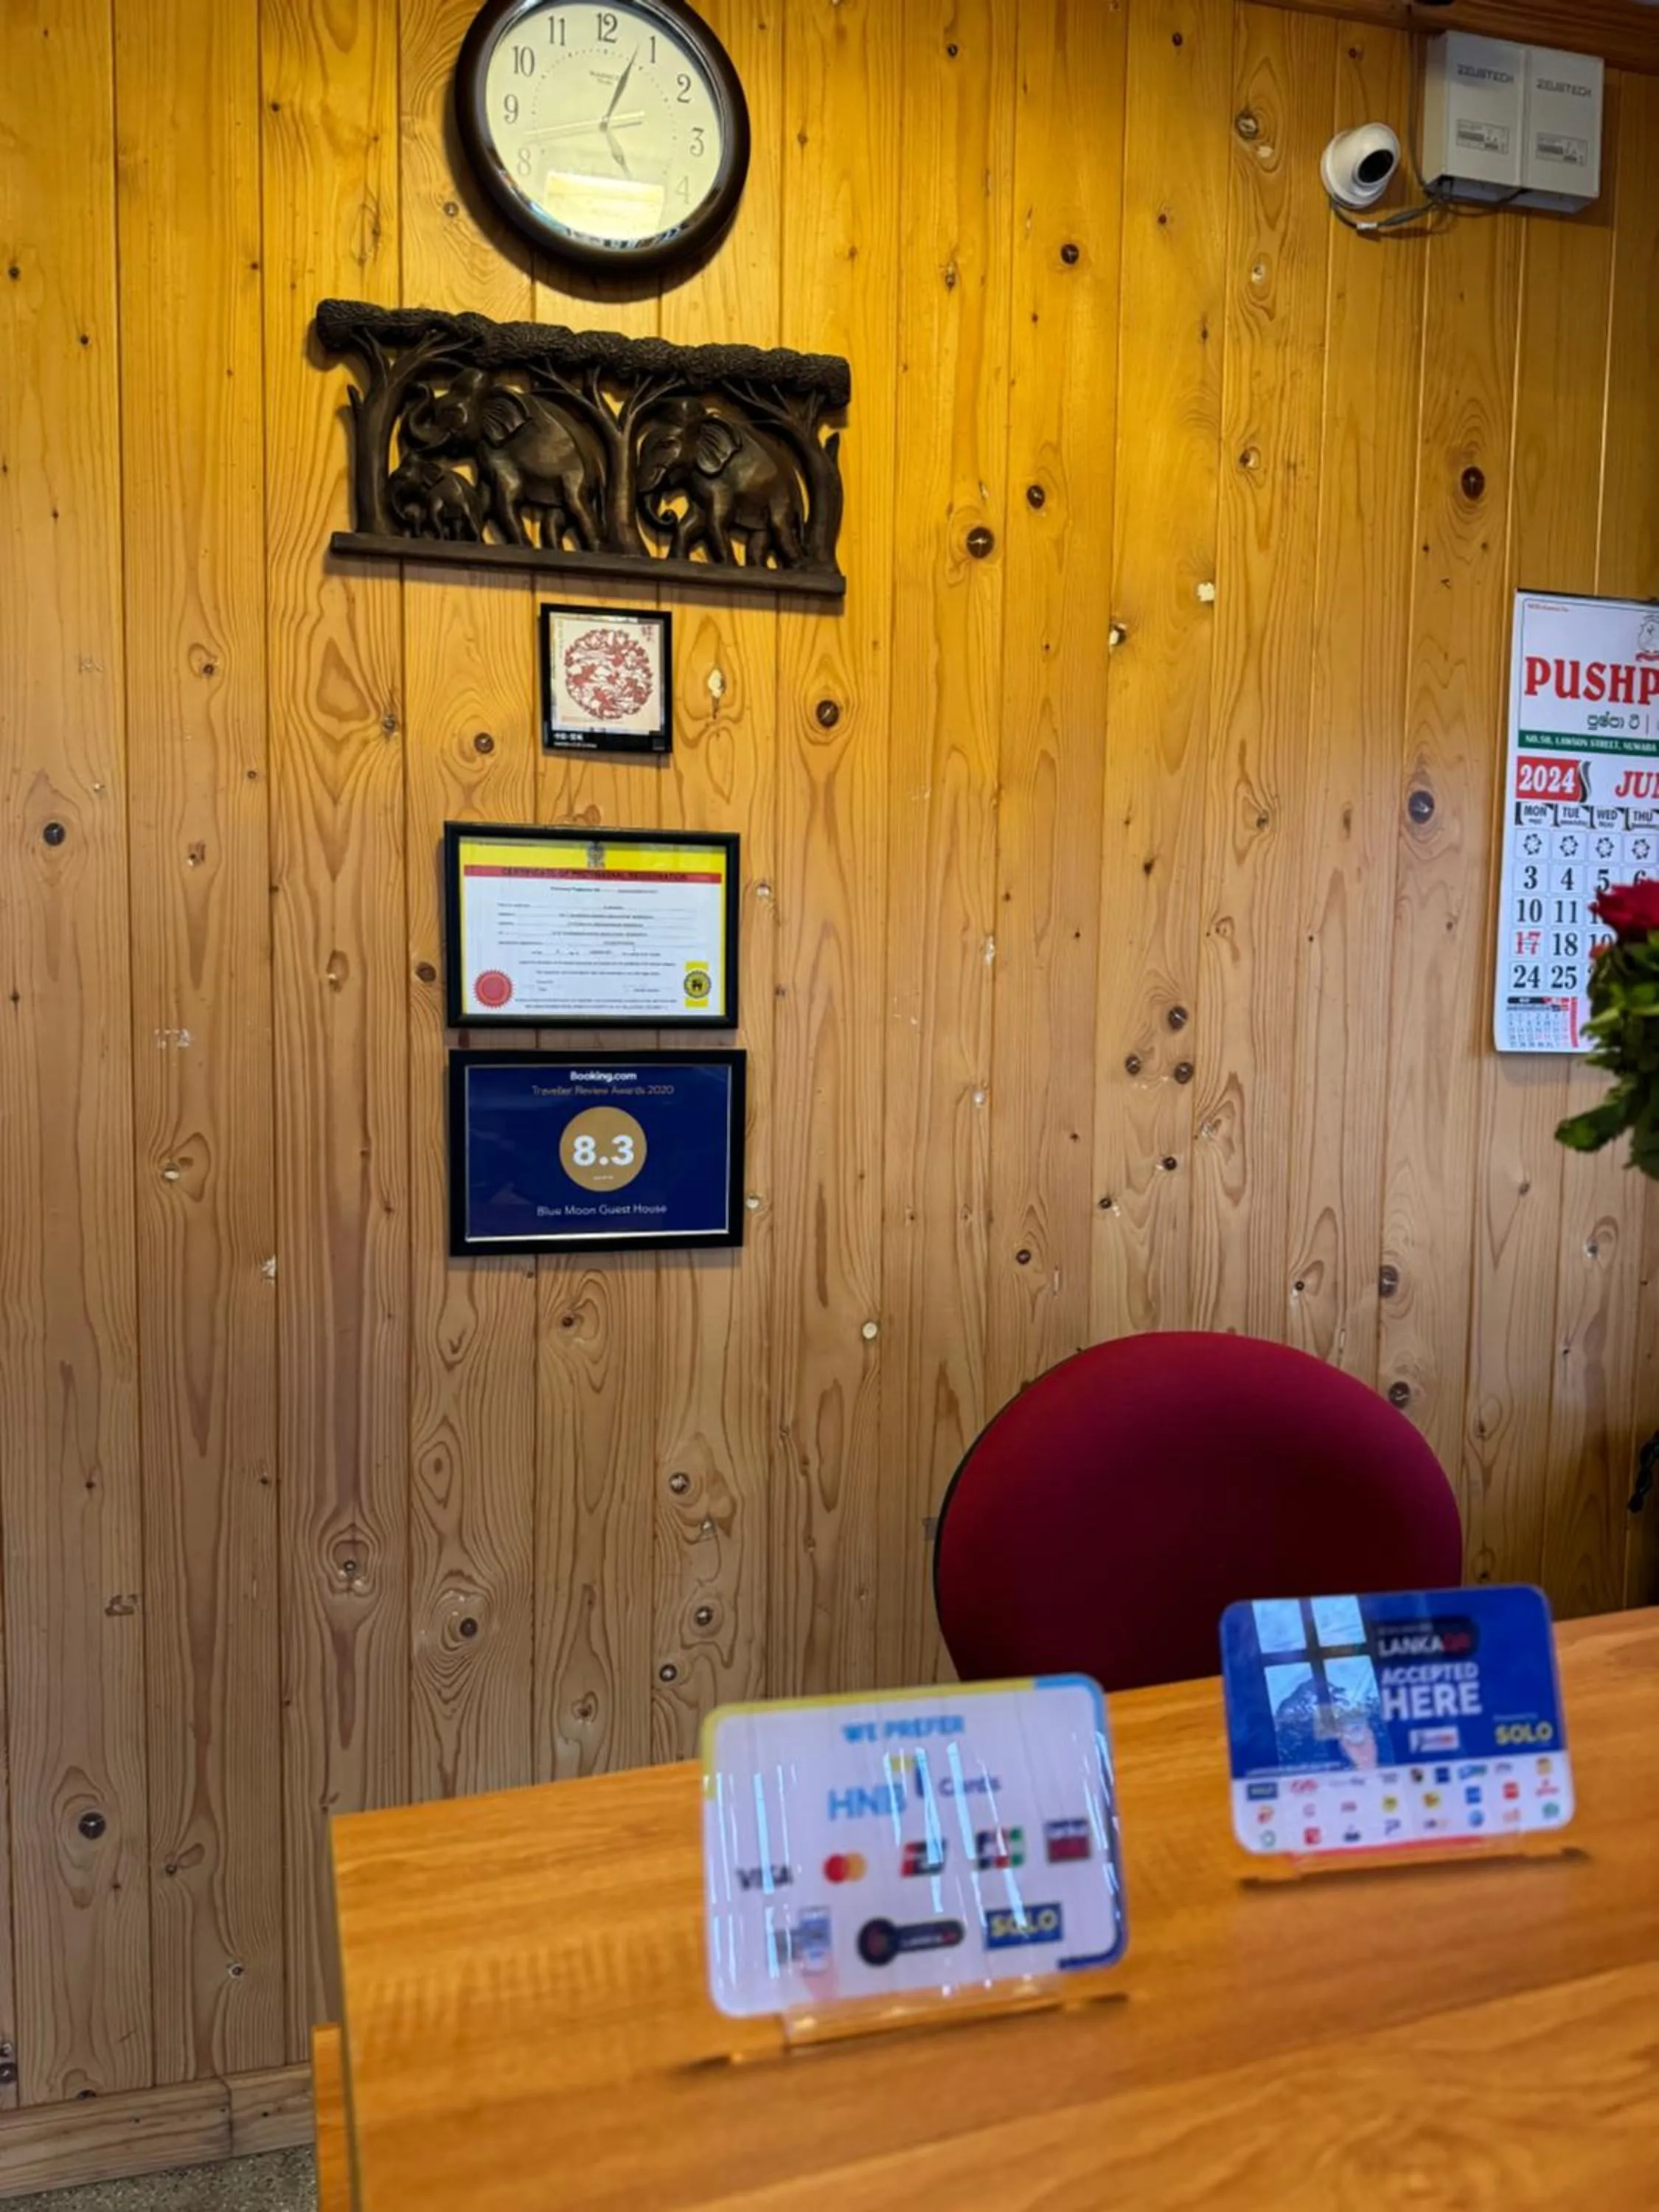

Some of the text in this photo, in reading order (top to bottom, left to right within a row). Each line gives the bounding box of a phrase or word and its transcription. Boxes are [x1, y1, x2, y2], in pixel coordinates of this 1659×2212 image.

[549, 15, 566, 46] 11
[596, 13, 618, 44] 12
[512, 45, 535, 77] 10
[649, 35, 656, 63] 1
[676, 74, 692, 103] 2
[504, 94, 519, 124] 9
[690, 127, 705, 157] 3
[516, 147, 532, 177] 8
[675, 175, 690, 204] 4
[1525, 656, 1659, 706] PUSHP
[1518, 765, 1576, 794] 2024
[1615, 771, 1659, 799] JU
[1523, 805, 1653, 822] MON TUE WED THU
[1523, 866, 1537, 889] 3
[1561, 868, 1573, 891] 4
[1596, 869, 1610, 892] 5
[1517, 899, 1543, 922] 10
[1555, 900, 1578, 923] 11
[1516, 932, 1541, 955] 17
[1553, 933, 1578, 957] 18
[1513, 964, 1540, 989] 24
[1551, 965, 1578, 990] 25
[569, 1071, 637, 1082] Booking.com
[647, 1085, 675, 1095] 2020
[572, 1134, 634, 1166] 8.3
[537, 1203, 667, 1216] Blue Moon Guest House
[1381, 1661, 1480, 1685] ACCEPTED
[1381, 1681, 1483, 1722] HERE
[842, 1715, 965, 1744] WE PREFER
[1495, 1721, 1554, 1747] SOLO
[827, 1776, 1001, 1821] HNB Crds
[736, 1863, 794, 1893] VIA
